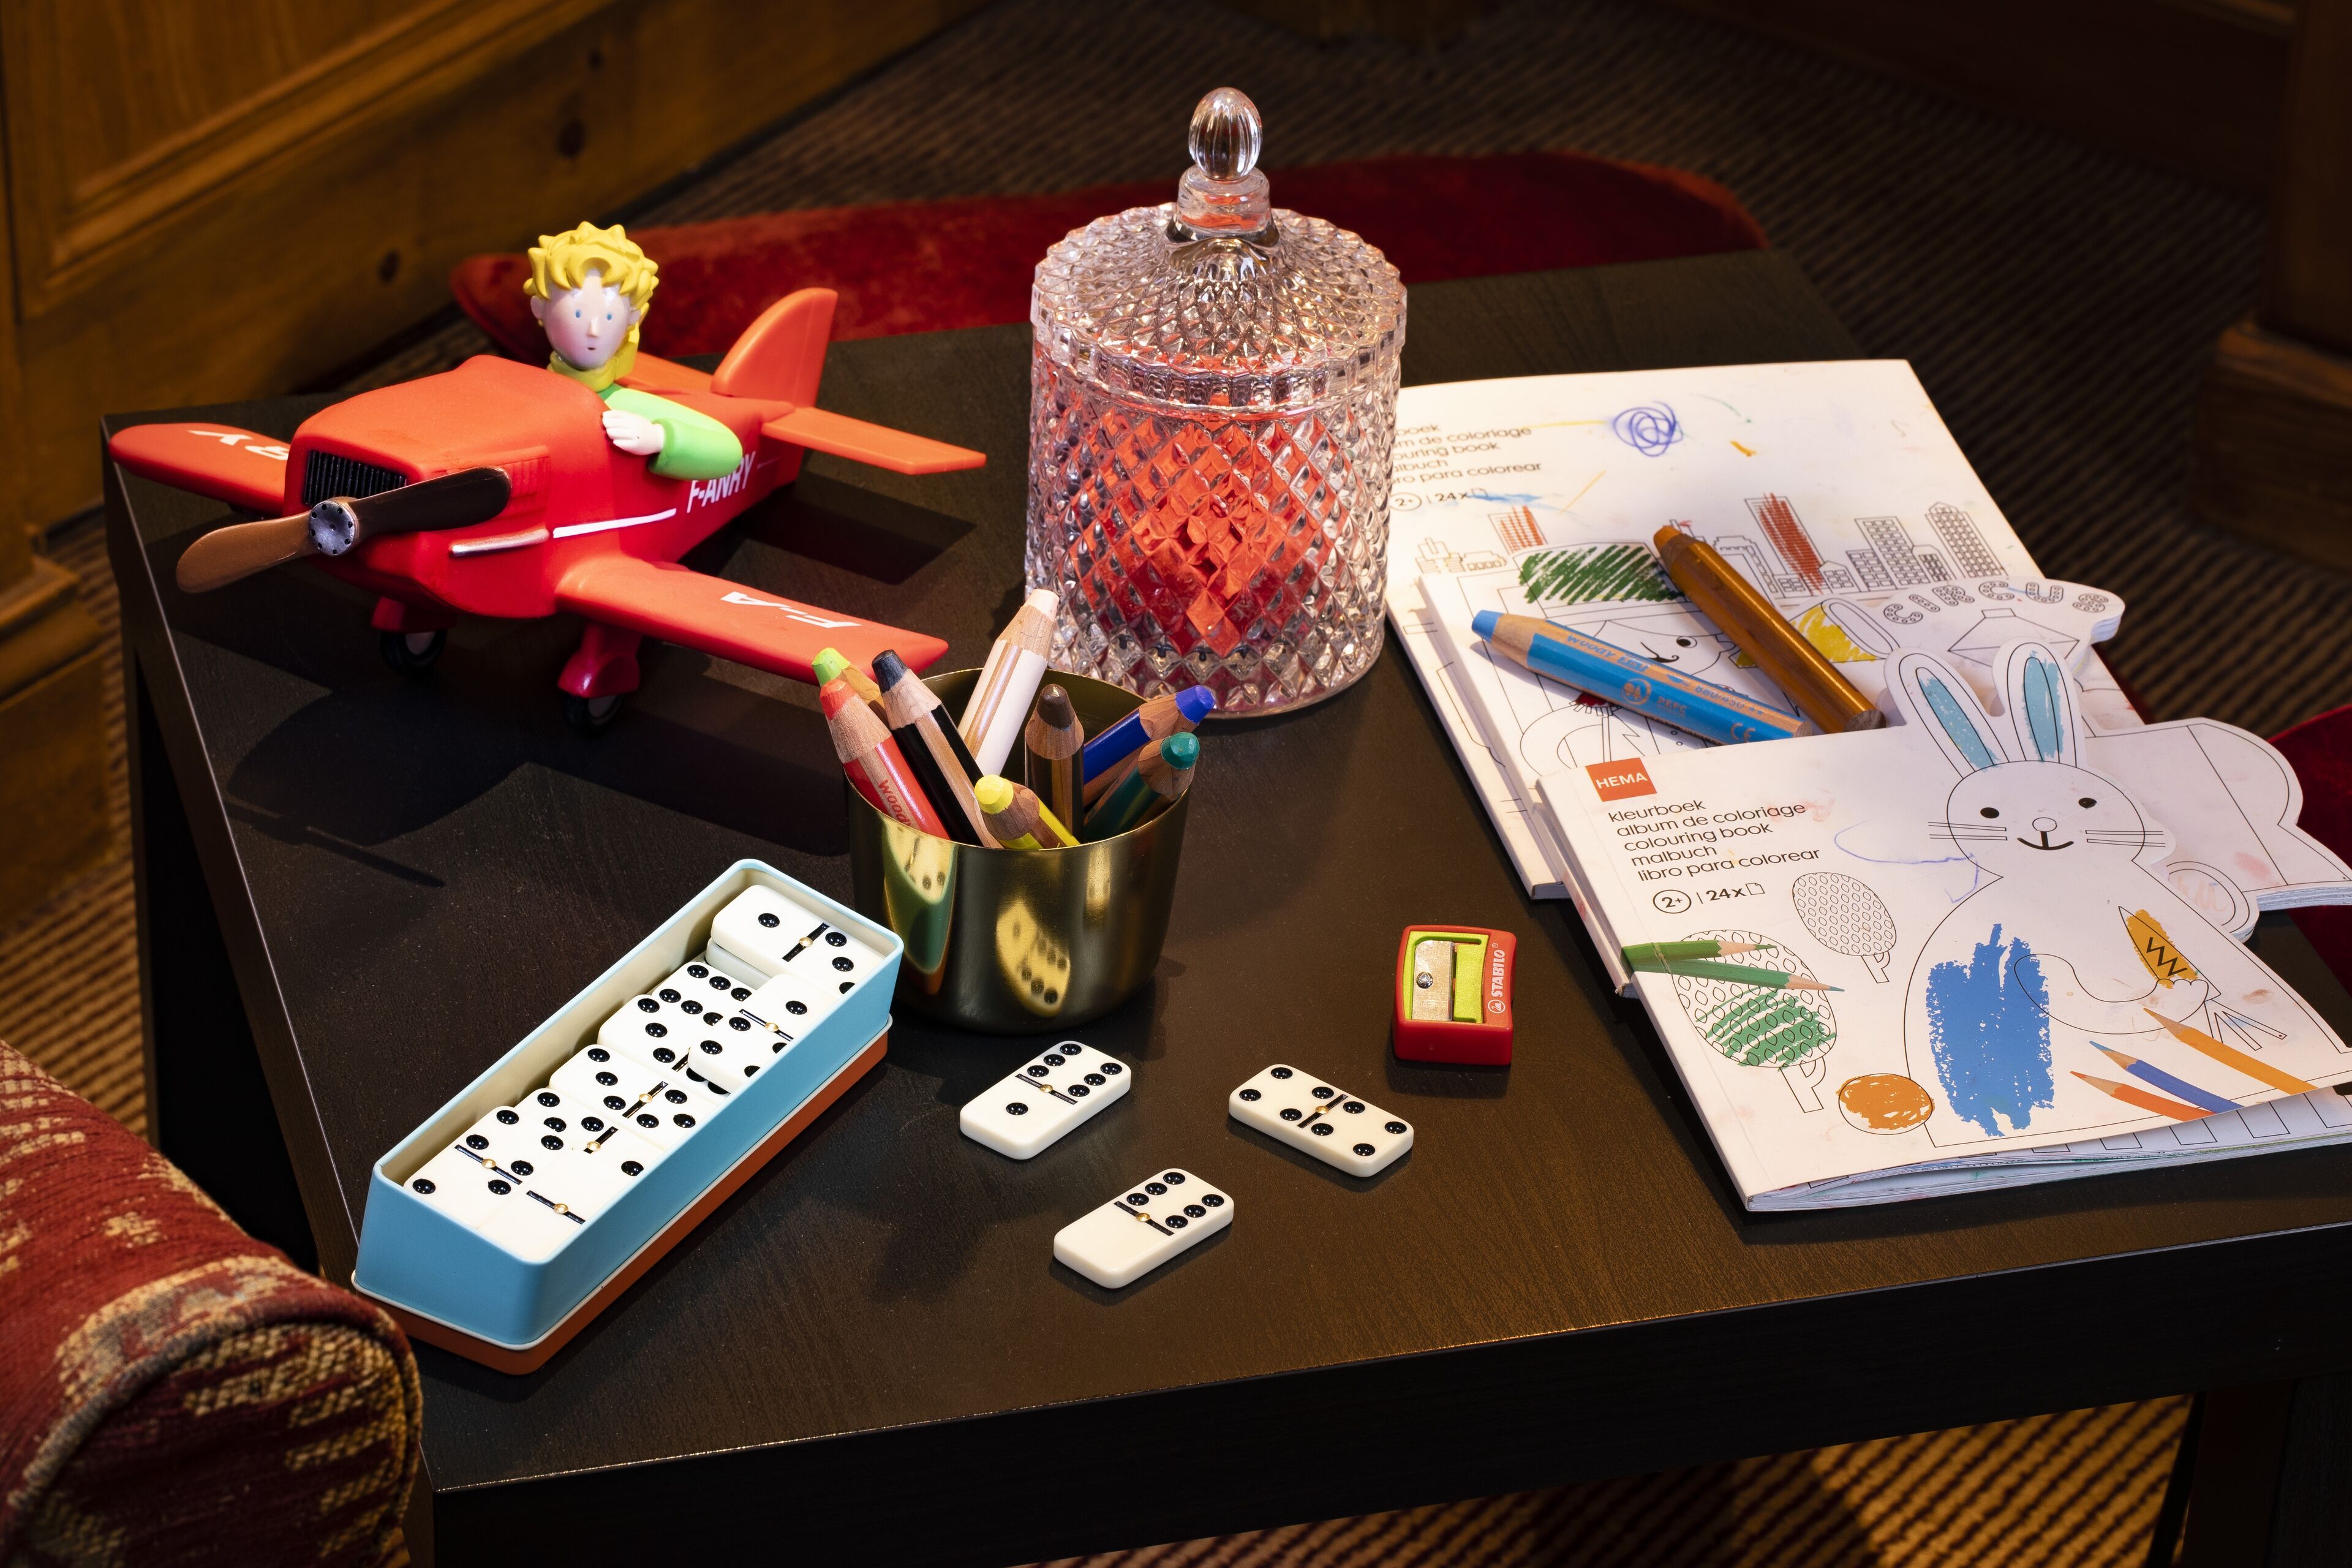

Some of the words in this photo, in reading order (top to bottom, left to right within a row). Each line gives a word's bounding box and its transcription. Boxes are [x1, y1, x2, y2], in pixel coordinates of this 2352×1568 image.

[1419, 435, 1442, 445] de
[1446, 428, 1532, 442] coloriage
[1392, 446, 1449, 461] ouring
[1452, 442, 1501, 454] book
[1419, 469, 1463, 483] para
[1466, 462, 1542, 477] colorear
[1883, 580, 2109, 624] CIRCUS
[1566, 635, 1617, 658] woody
[1595, 772, 1648, 790] HEMA
[1608, 799, 1707, 823] kleurboek
[1616, 820, 1679, 837] album
[1682, 815, 1709, 827] de
[1713, 804, 1807, 824] coloriage
[1624, 829, 1718, 851] colouring
[1719, 823, 1774, 839] book
[1630, 845, 1718, 867] malbuch
[1637, 865, 1683, 882] libro
[1686, 859, 1735, 878] para
[1738, 848, 1820, 868] colorear
[1661, 896, 1684, 908] 2+
[1705, 888, 1747, 902] 24x
[1491, 949, 1506, 998] STABILO
